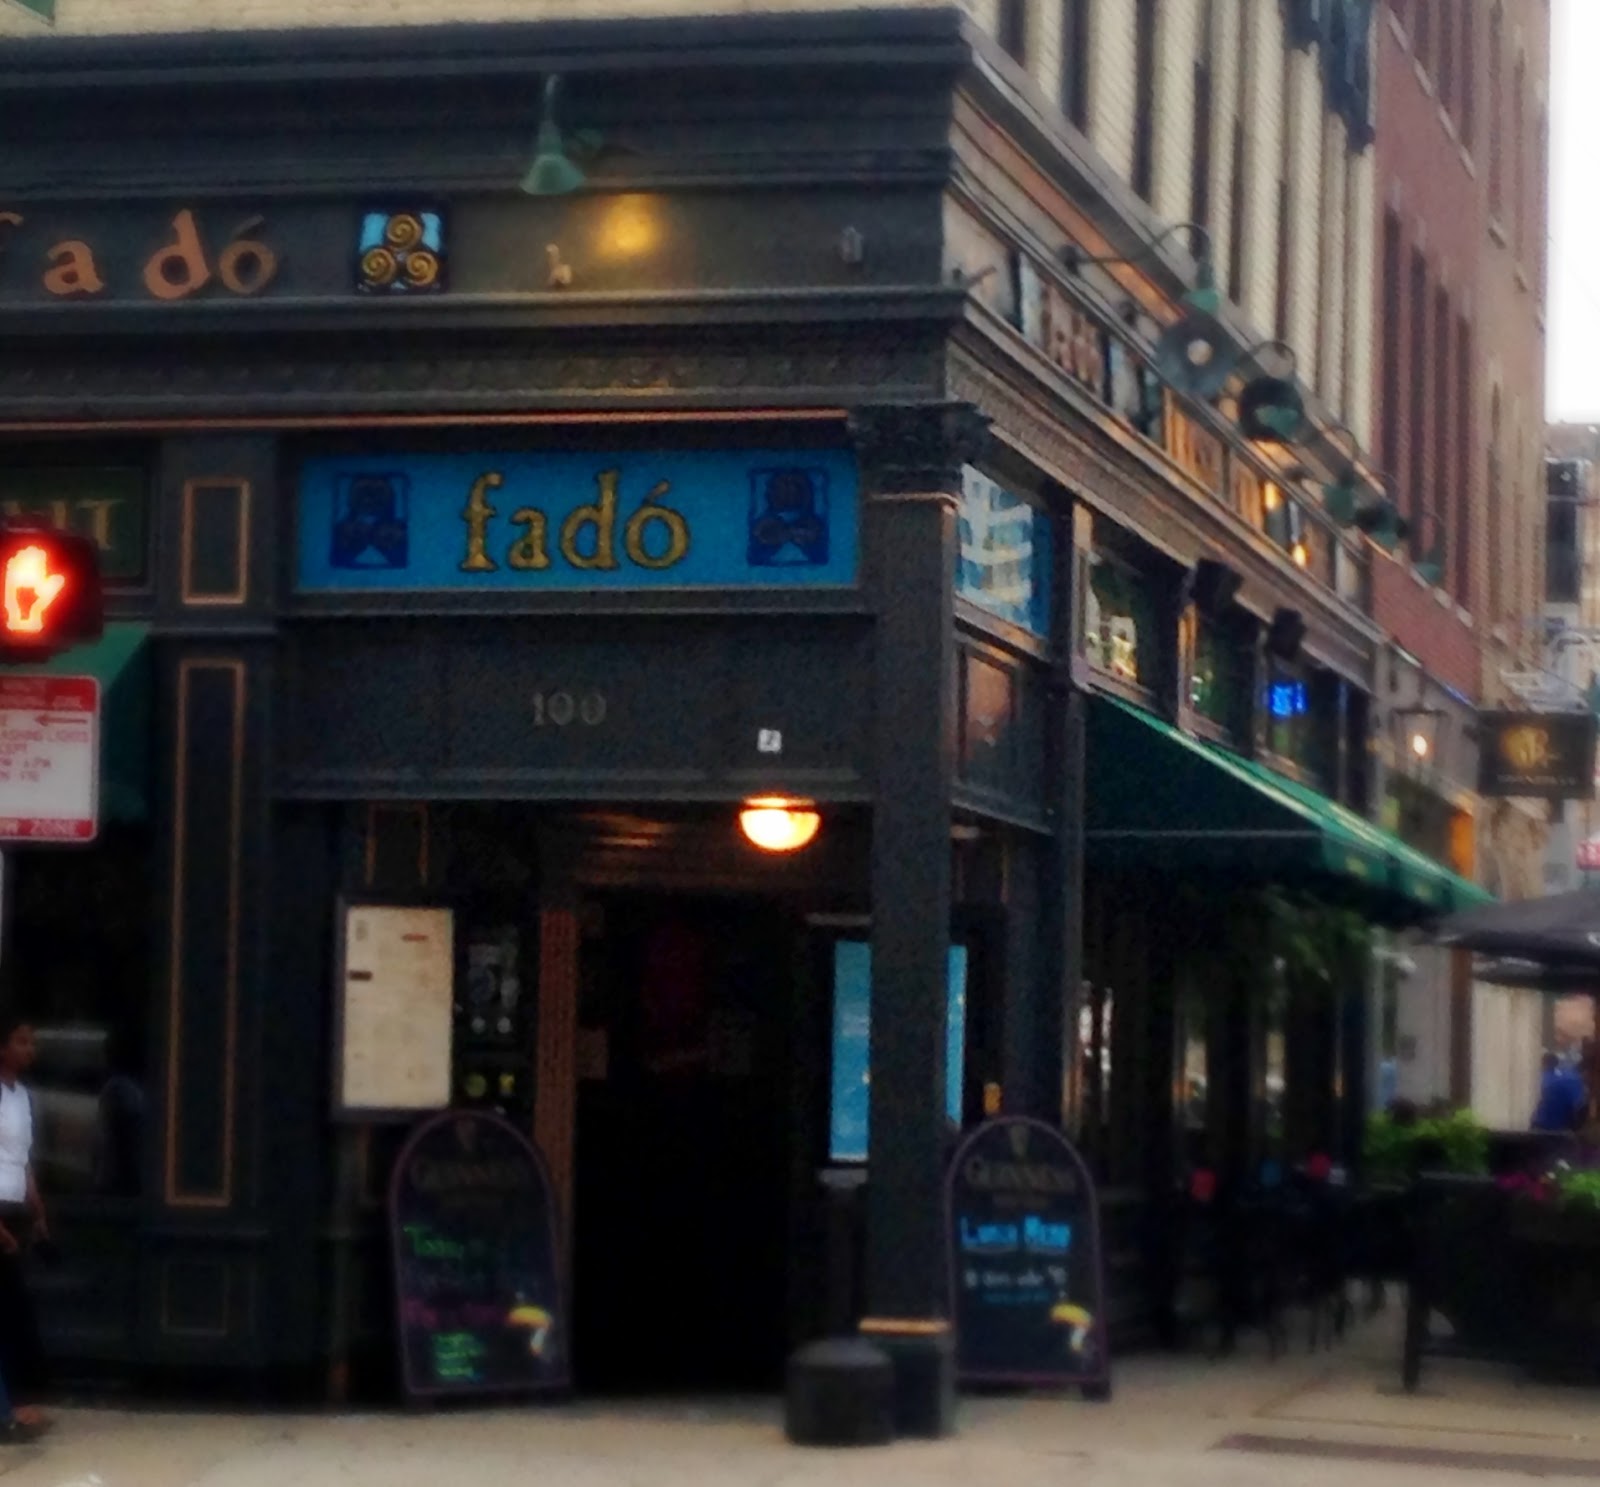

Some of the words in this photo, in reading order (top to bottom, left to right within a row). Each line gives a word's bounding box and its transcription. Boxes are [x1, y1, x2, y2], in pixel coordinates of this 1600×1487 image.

[0, 208, 277, 299] adó
[459, 469, 691, 571] fadó
[531, 691, 607, 726] 100
